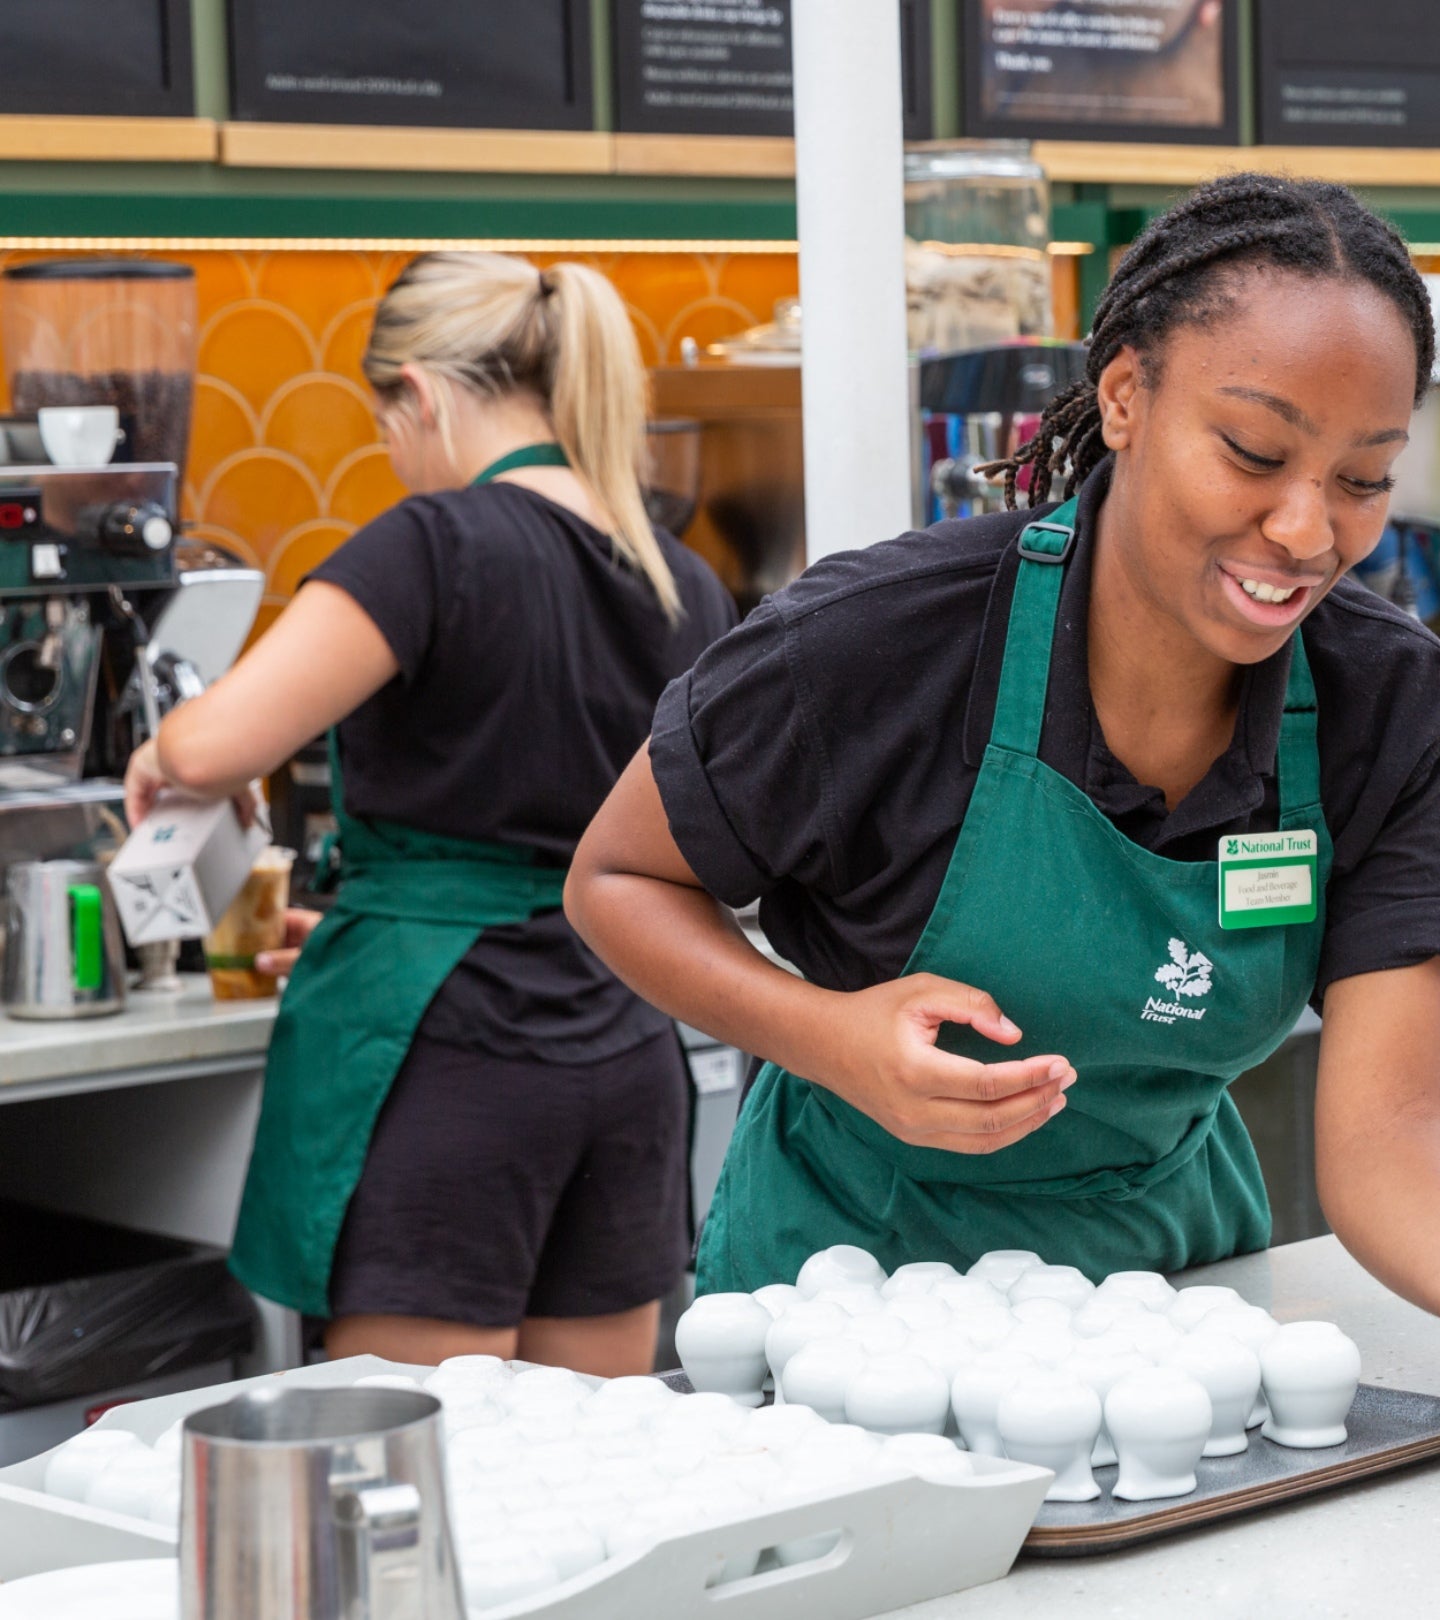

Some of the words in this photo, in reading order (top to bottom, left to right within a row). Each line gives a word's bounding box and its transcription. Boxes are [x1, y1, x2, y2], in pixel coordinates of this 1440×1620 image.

[1241, 838, 1284, 853] National
[1287, 837, 1311, 851] Trust
[1238, 884, 1256, 894] Food
[1257, 883, 1268, 892] and
[1269, 881, 1298, 892] Beverage
[1145, 996, 1206, 1020] National
